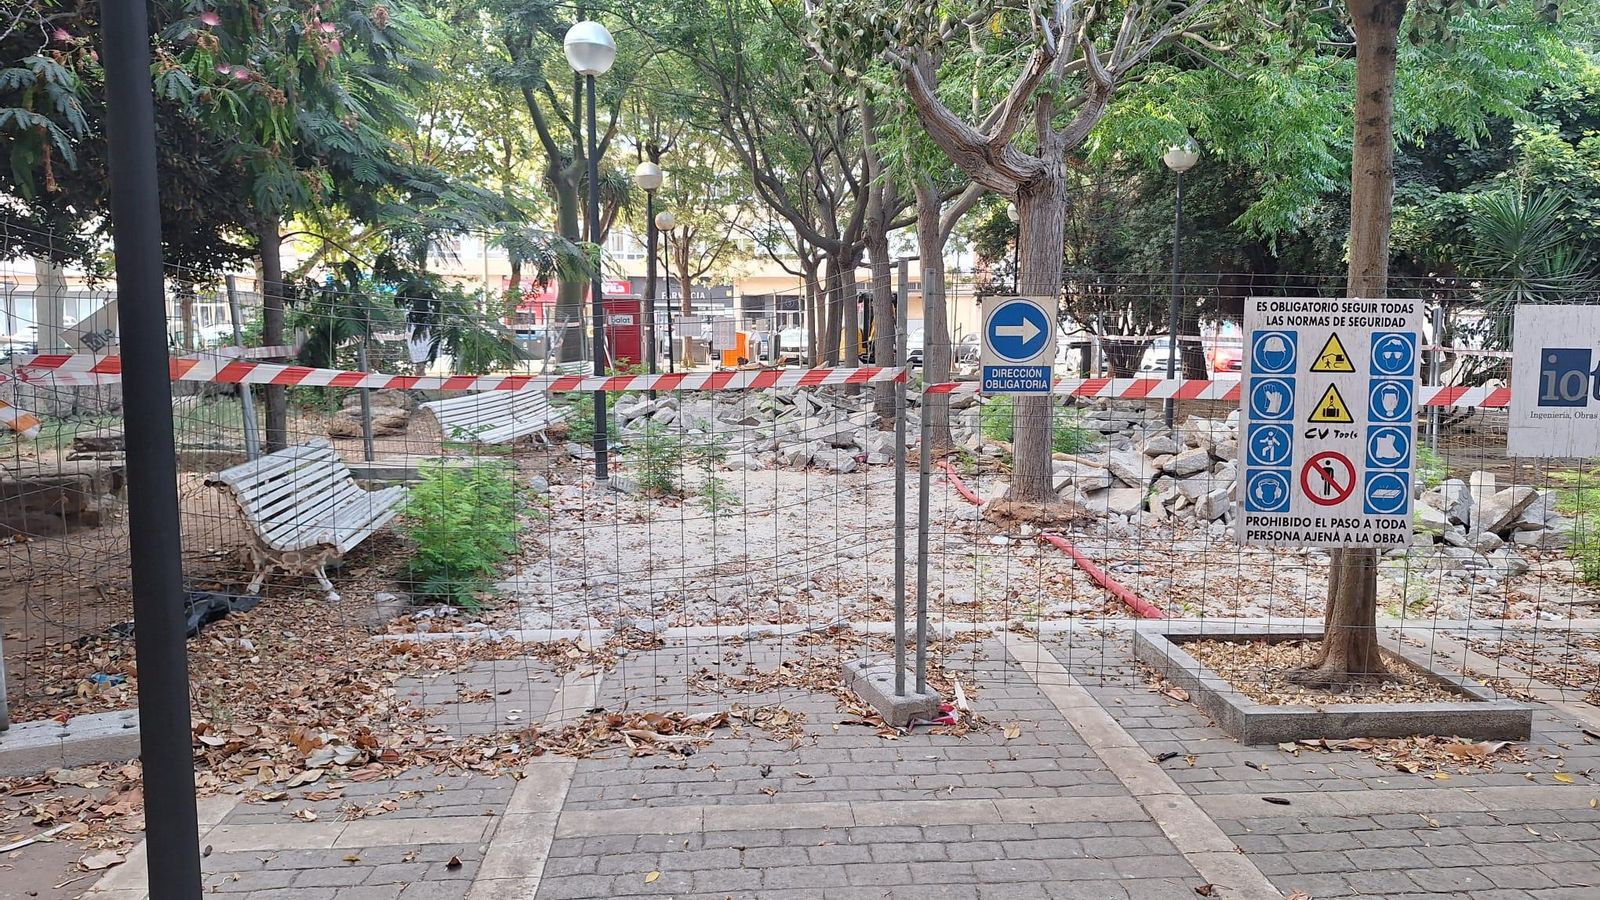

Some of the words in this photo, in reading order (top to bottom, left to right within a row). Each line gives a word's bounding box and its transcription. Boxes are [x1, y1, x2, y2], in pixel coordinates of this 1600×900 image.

[1256, 301, 1267, 312] ES
[1270, 302, 1338, 313] OBLIGATORIO
[1341, 303, 1377, 313] SEGUIR
[1381, 303, 1414, 314] TODAS
[1266, 316, 1283, 326] LAS
[1287, 316, 1330, 327] NORMAS
[1333, 317, 1345, 327] DE
[1348, 317, 1406, 328] SEGURIDAD
[991, 367, 1042, 378] DIRECCIÓN
[985, 380, 1048, 389] OBLIGATORIA
[1574, 411, 1598, 419] Obras
[1304, 428, 1329, 440] CV
[1333, 429, 1358, 439] Tools
[1246, 516, 1311, 528] PROHIBIDO
[1315, 517, 1327, 528] EL
[1330, 518, 1360, 529] PASO
[1363, 519, 1372, 529] A
[1375, 519, 1407, 529] TODA
[1247, 530, 1300, 541] PERSONA
[1304, 532, 1341, 542] AJENA
[1344, 532, 1353, 543] A
[1356, 533, 1369, 543] LA
[1373, 533, 1405, 544] OBRA
